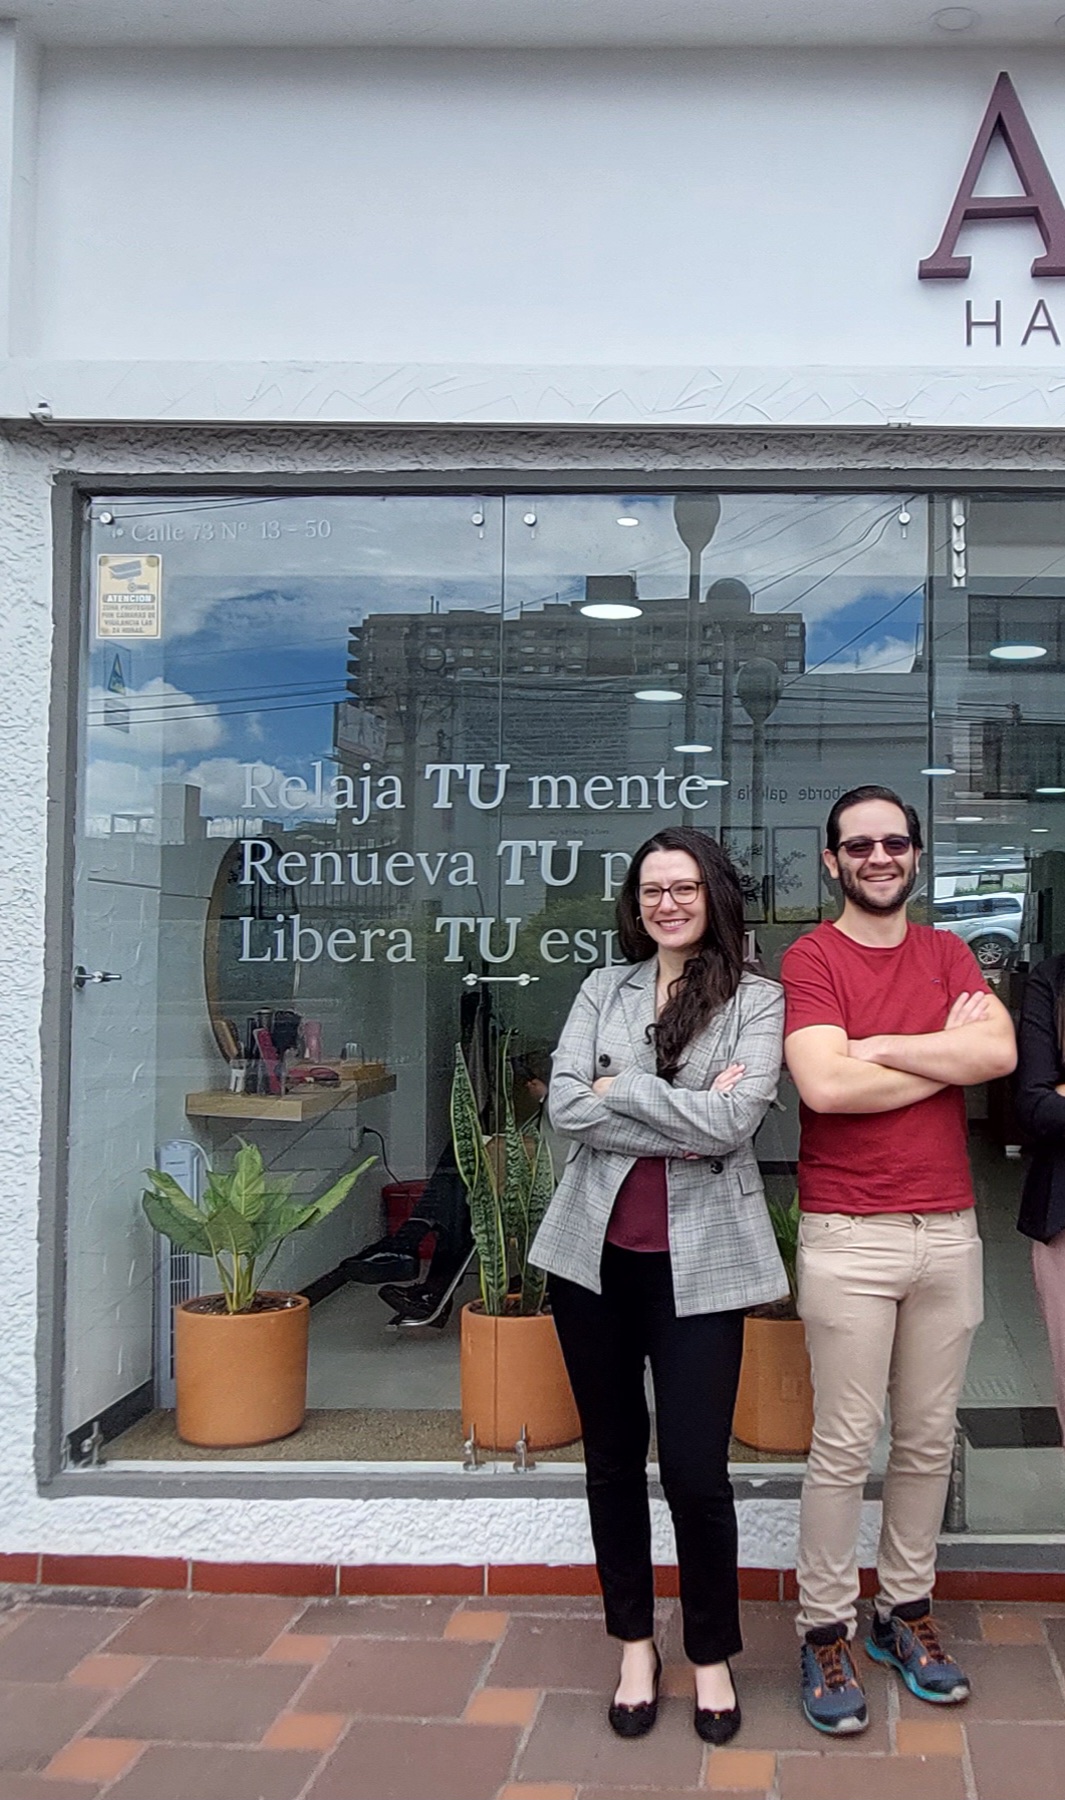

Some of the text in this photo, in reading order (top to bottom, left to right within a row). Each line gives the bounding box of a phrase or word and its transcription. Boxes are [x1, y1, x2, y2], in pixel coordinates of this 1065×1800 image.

[131, 521, 185, 542] Calle
[193, 521, 214, 541] 73
[261, 520, 282, 540] 13
[305, 519, 332, 538] 50
[106, 594, 152, 602] ATENCION
[239, 761, 709, 826] Relaja TU mente
[239, 840, 479, 886] Renueva
[496, 840, 583, 886] TU
[238, 914, 416, 963] Libera
[435, 917, 522, 963] TU
